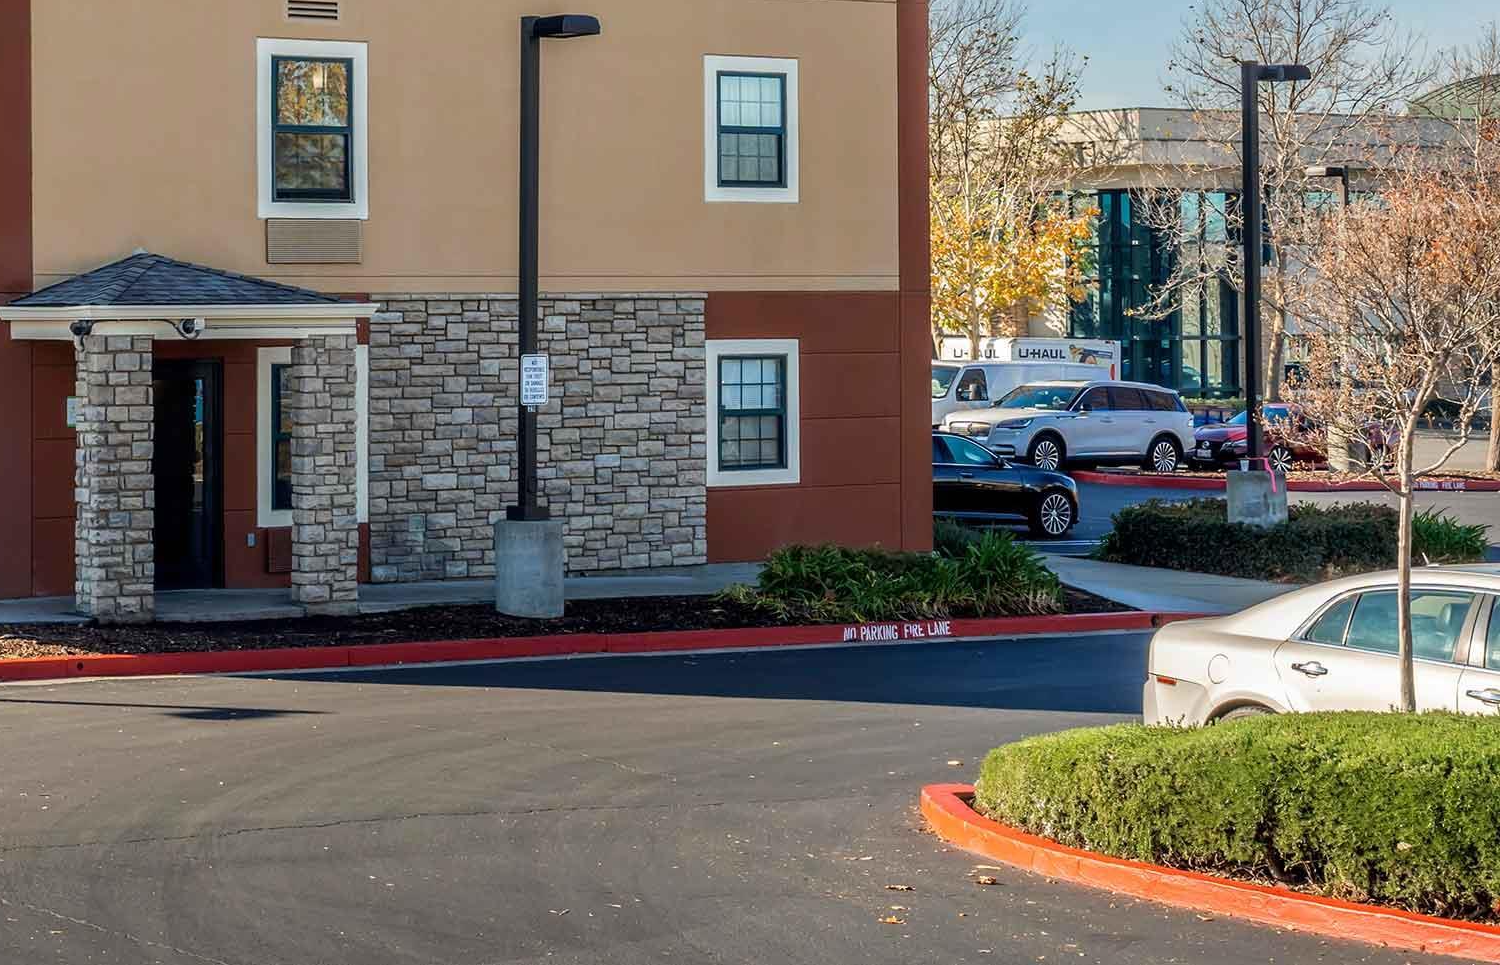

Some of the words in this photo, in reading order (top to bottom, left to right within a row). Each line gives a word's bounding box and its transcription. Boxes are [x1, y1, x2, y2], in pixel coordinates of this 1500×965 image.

[953, 348, 1000, 359] U-UL
[1018, 348, 1066, 360] U-HAUL
[843, 627, 857, 641] NO
[860, 624, 899, 641] PARKING
[904, 623, 925, 638] FIRE
[927, 621, 952, 636] LANE
